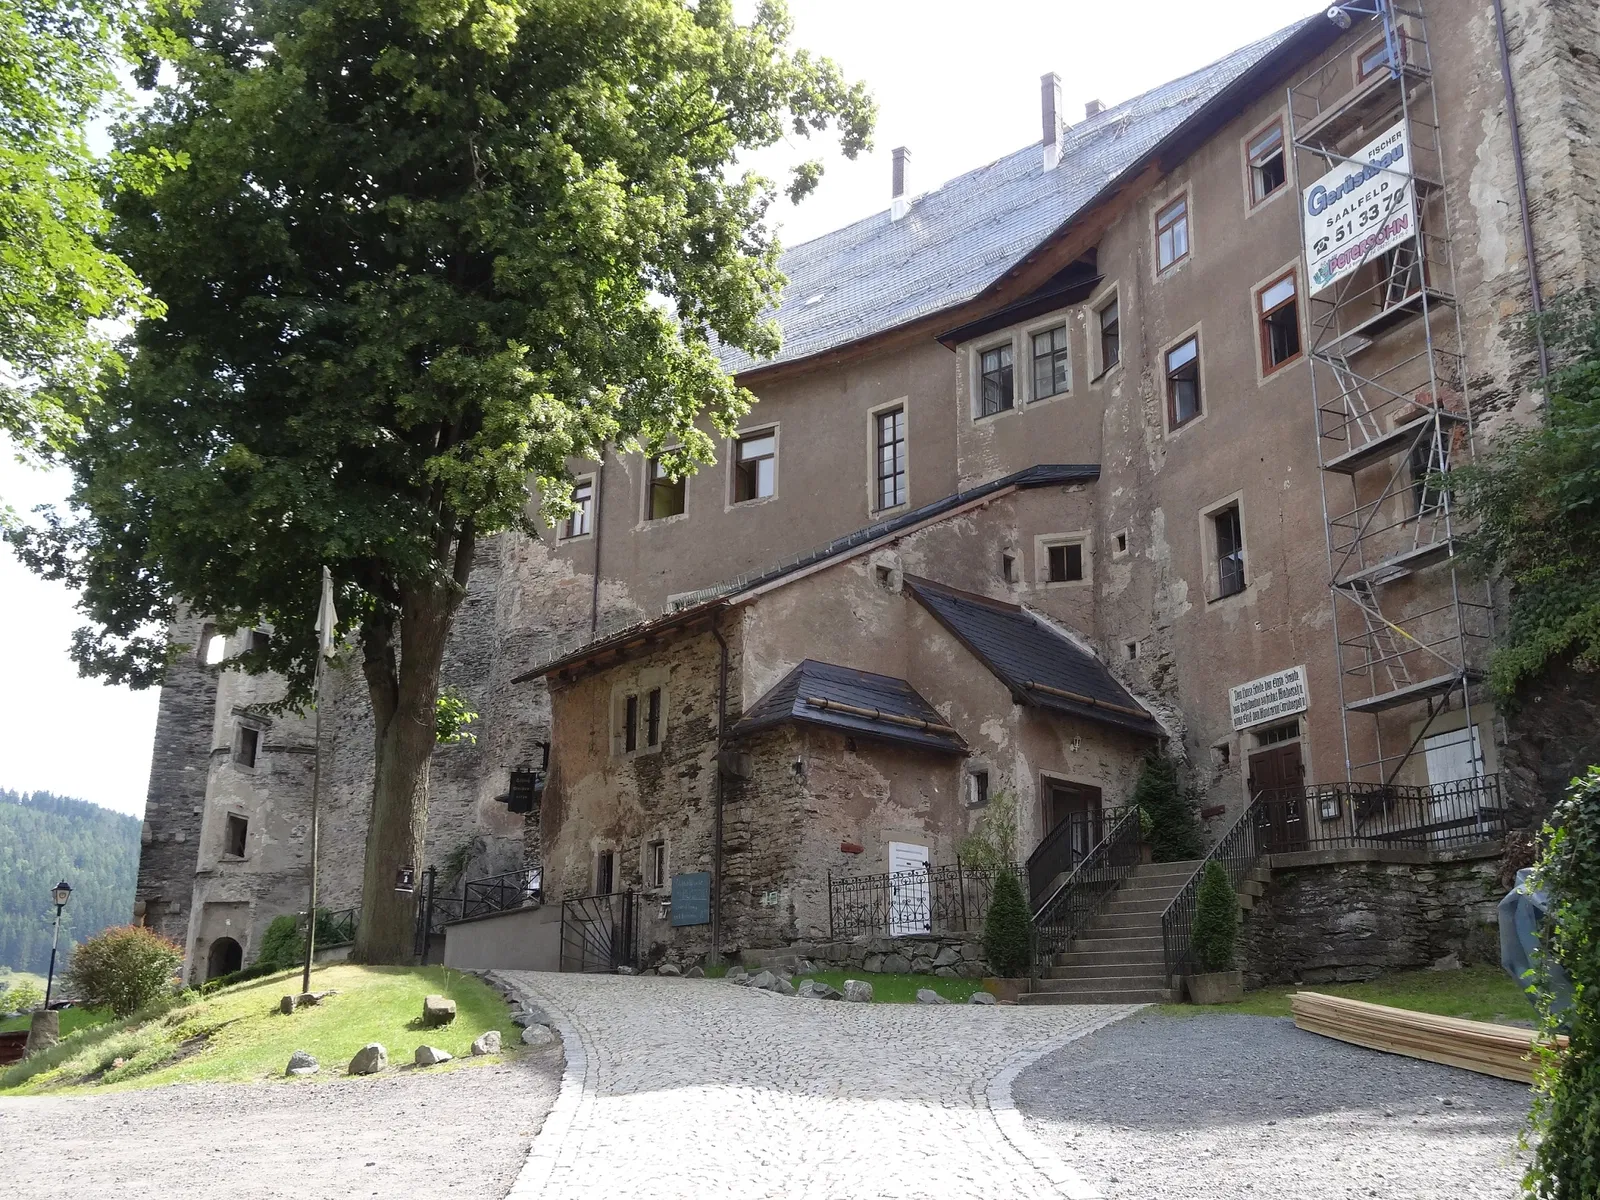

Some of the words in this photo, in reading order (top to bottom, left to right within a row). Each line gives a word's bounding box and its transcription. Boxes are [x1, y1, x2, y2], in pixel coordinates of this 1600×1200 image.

[1368, 131, 1402, 158] FISCHER
[1308, 143, 1404, 216] Gerüstbau
[1326, 182, 1389, 227] SAALFELD
[1335, 220, 1353, 242] 51
[1358, 203, 1380, 227] 33
